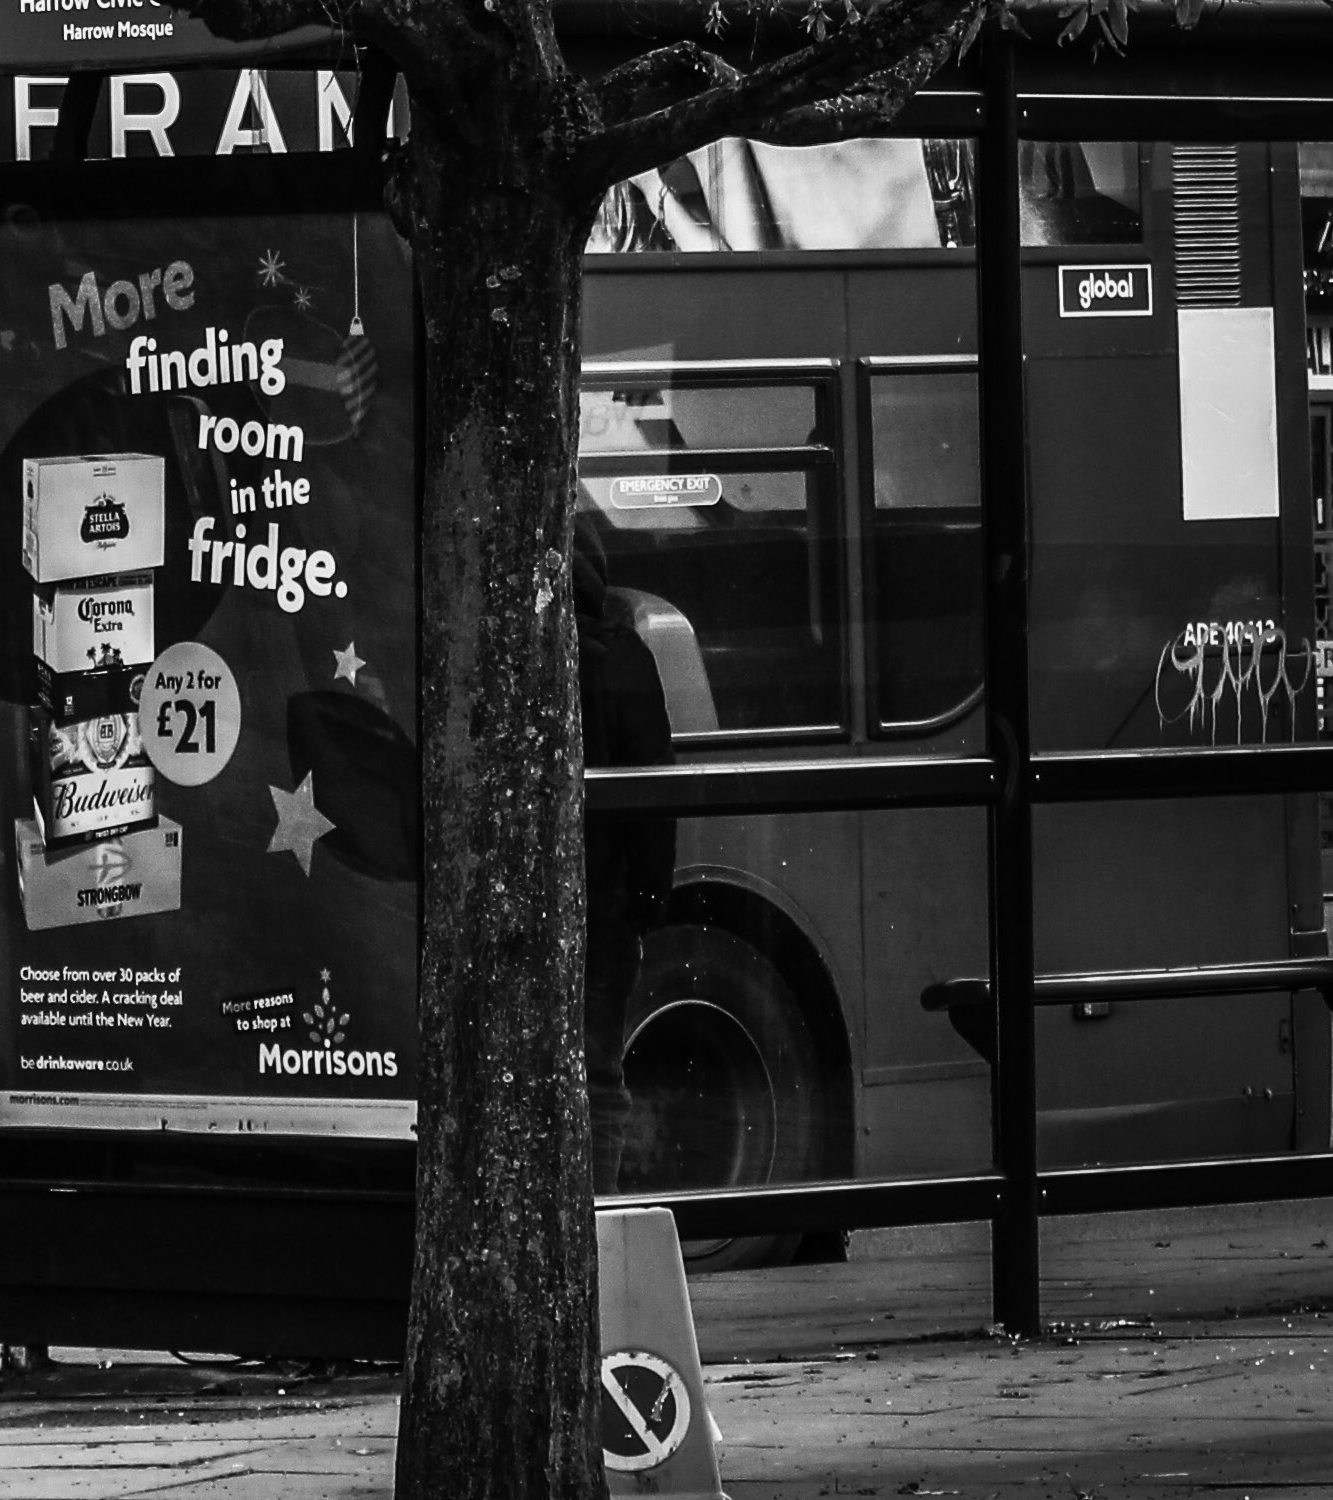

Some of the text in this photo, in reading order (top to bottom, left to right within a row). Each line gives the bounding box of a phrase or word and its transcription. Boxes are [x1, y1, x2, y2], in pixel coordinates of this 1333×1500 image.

[63, 20, 173, 41] Harrow Mosque
[1078, 271, 1134, 309] global
[48, 260, 195, 350] More
[126, 326, 286, 396] finding
[198, 414, 304, 462] room
[229, 469, 311, 515] in the
[619, 477, 711, 493] EMERGENCY EXIT
[89, 512, 121, 523] STELLA
[89, 521, 121, 534] ARTOIS
[188, 516, 348, 613] fridge.
[77, 597, 135, 623] Corona
[94, 618, 123, 634] Extra
[1183, 621, 1219, 647] ADE
[155, 670, 221, 694] Any 2 for
[157, 699, 216, 754] £21
[53, 779, 154, 820] Budweiser
[77, 882, 143, 907] STRONGBOW
[20, 965, 181, 986] Choose from over 30 packs of
[20, 987, 183, 1010] beer and cider. A cracking deal
[222, 992, 294, 1015] More reasons
[21, 1010, 172, 1028] available until the New Year.
[236, 1015, 291, 1033] to shop at
[259, 1042, 398, 1077] Morrisons
[9, 1093, 79, 1106] morrisons.com
